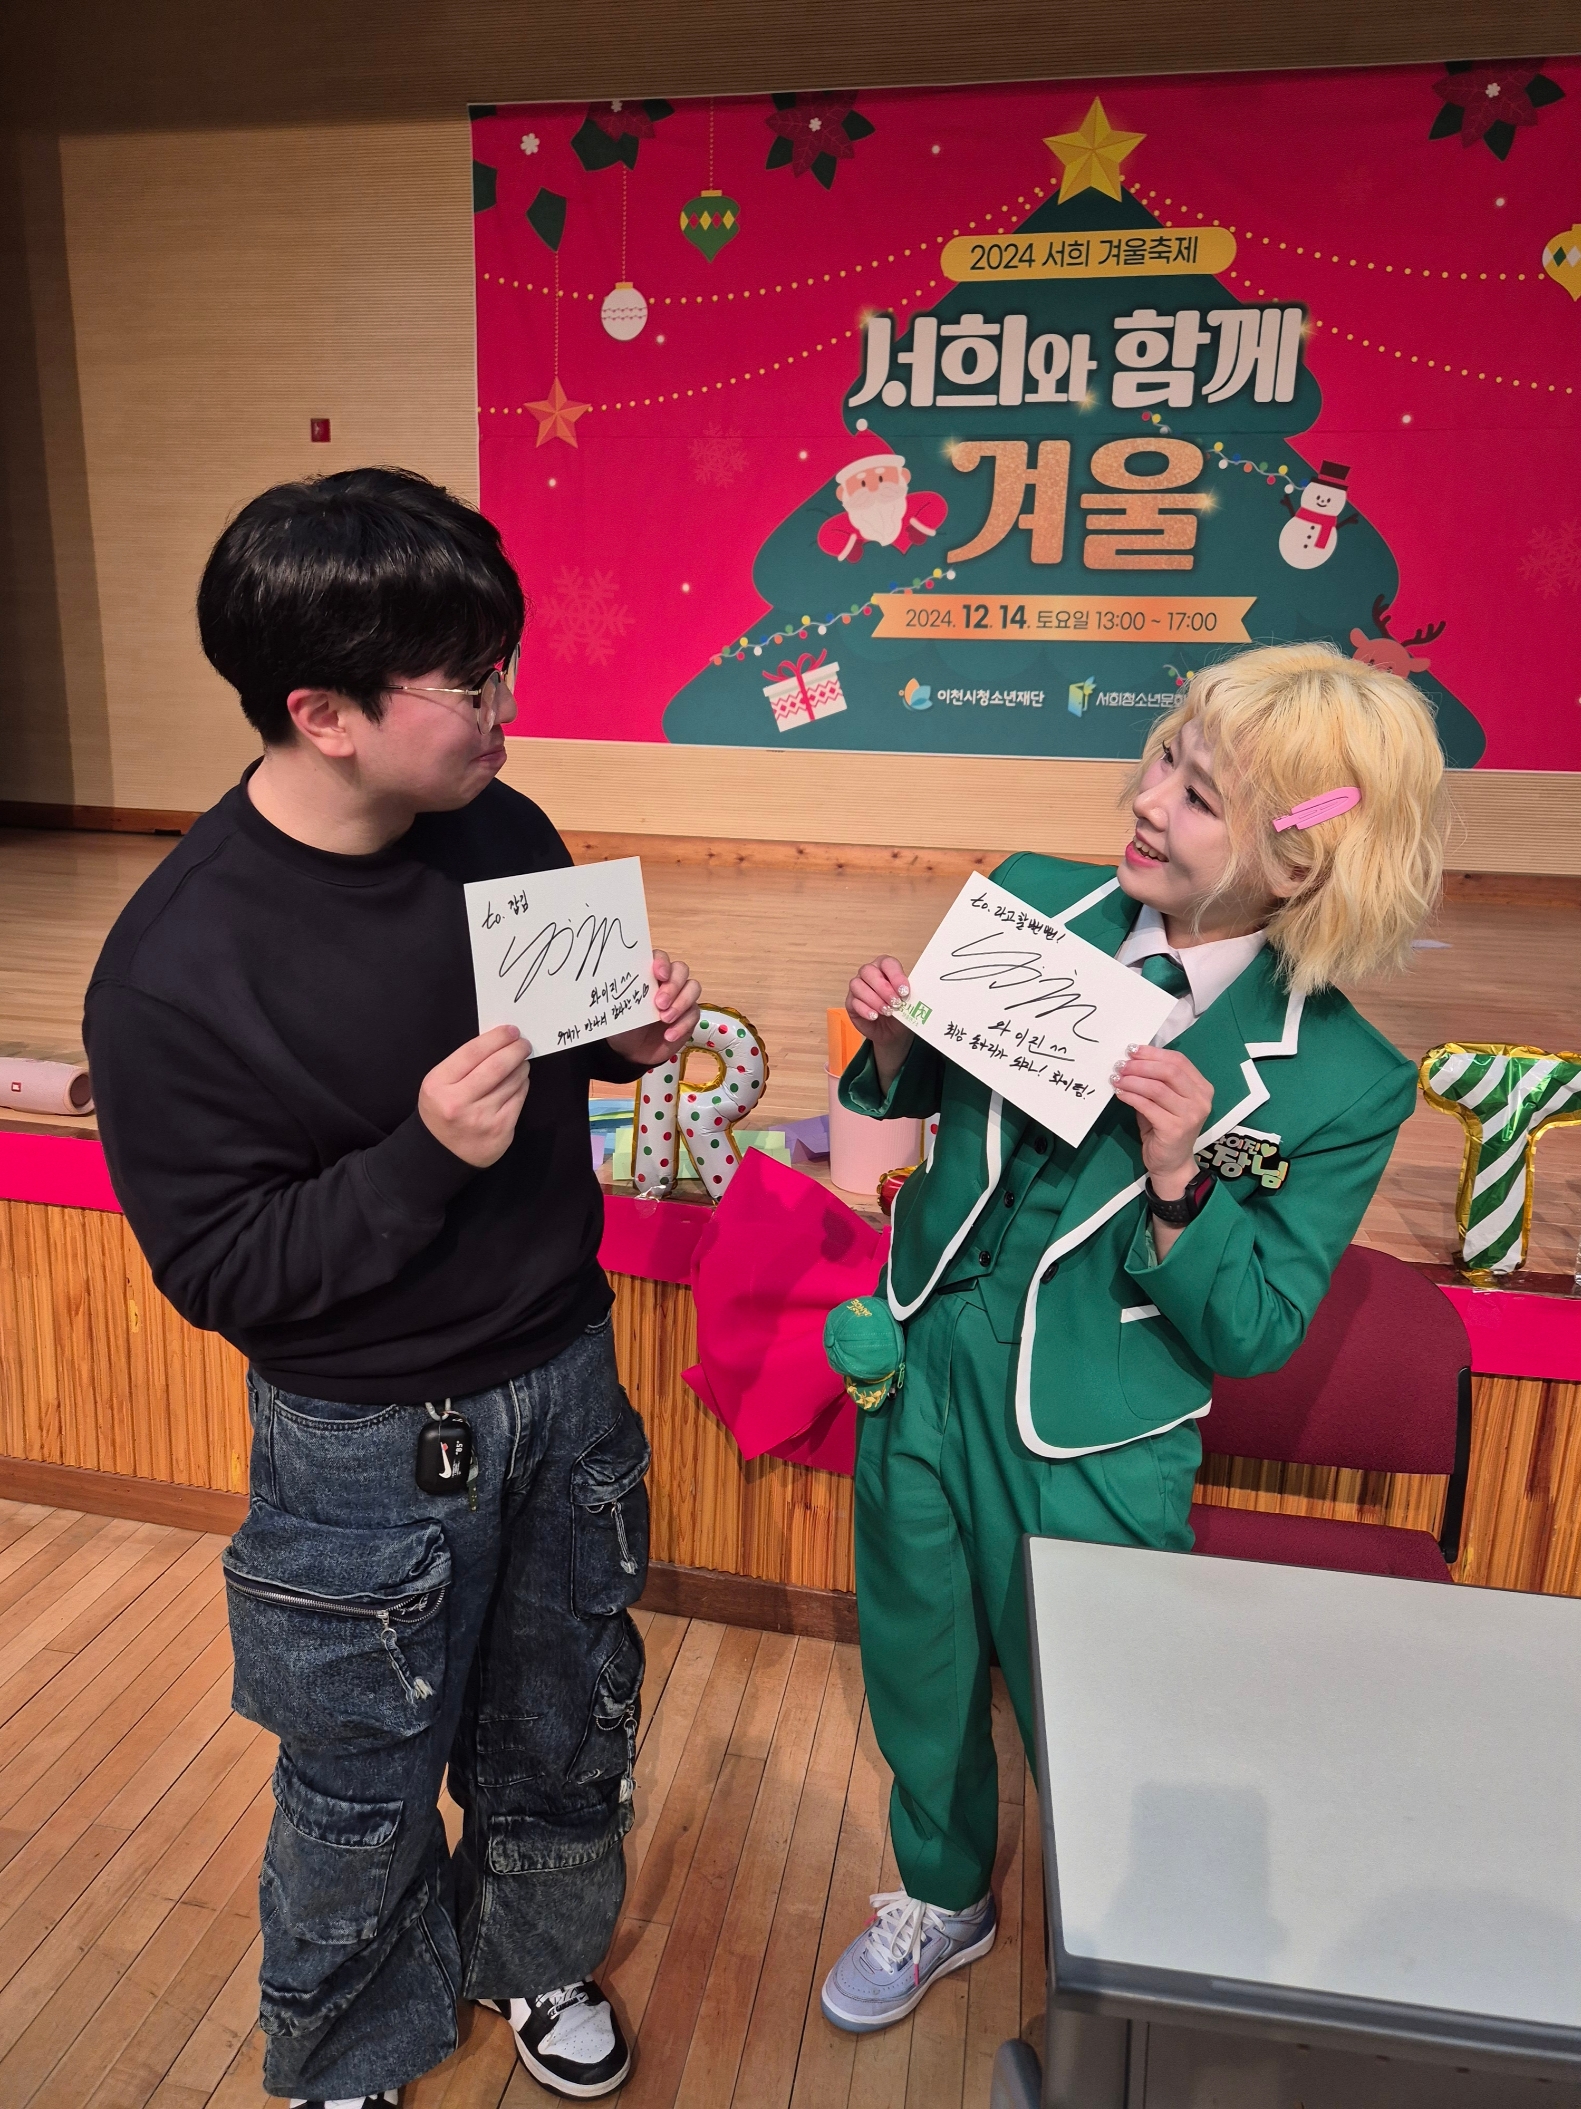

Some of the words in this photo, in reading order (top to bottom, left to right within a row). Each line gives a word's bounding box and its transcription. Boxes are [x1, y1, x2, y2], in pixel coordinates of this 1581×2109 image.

[970, 243, 1035, 271] 2024
[1041, 239, 1091, 268] 서희
[1097, 235, 1199, 267] 겨울축제
[848, 313, 1098, 408] 서희와
[1112, 308, 1303, 408] 함께
[947, 437, 1208, 571] 겨울
[905, 608, 956, 628] 2024.
[1036, 610, 1090, 630] 토요일
[1095, 611, 1146, 631] 13:00
[1167, 611, 1218, 632] 17:00
[937, 688, 1046, 708] 이천시청소년재단
